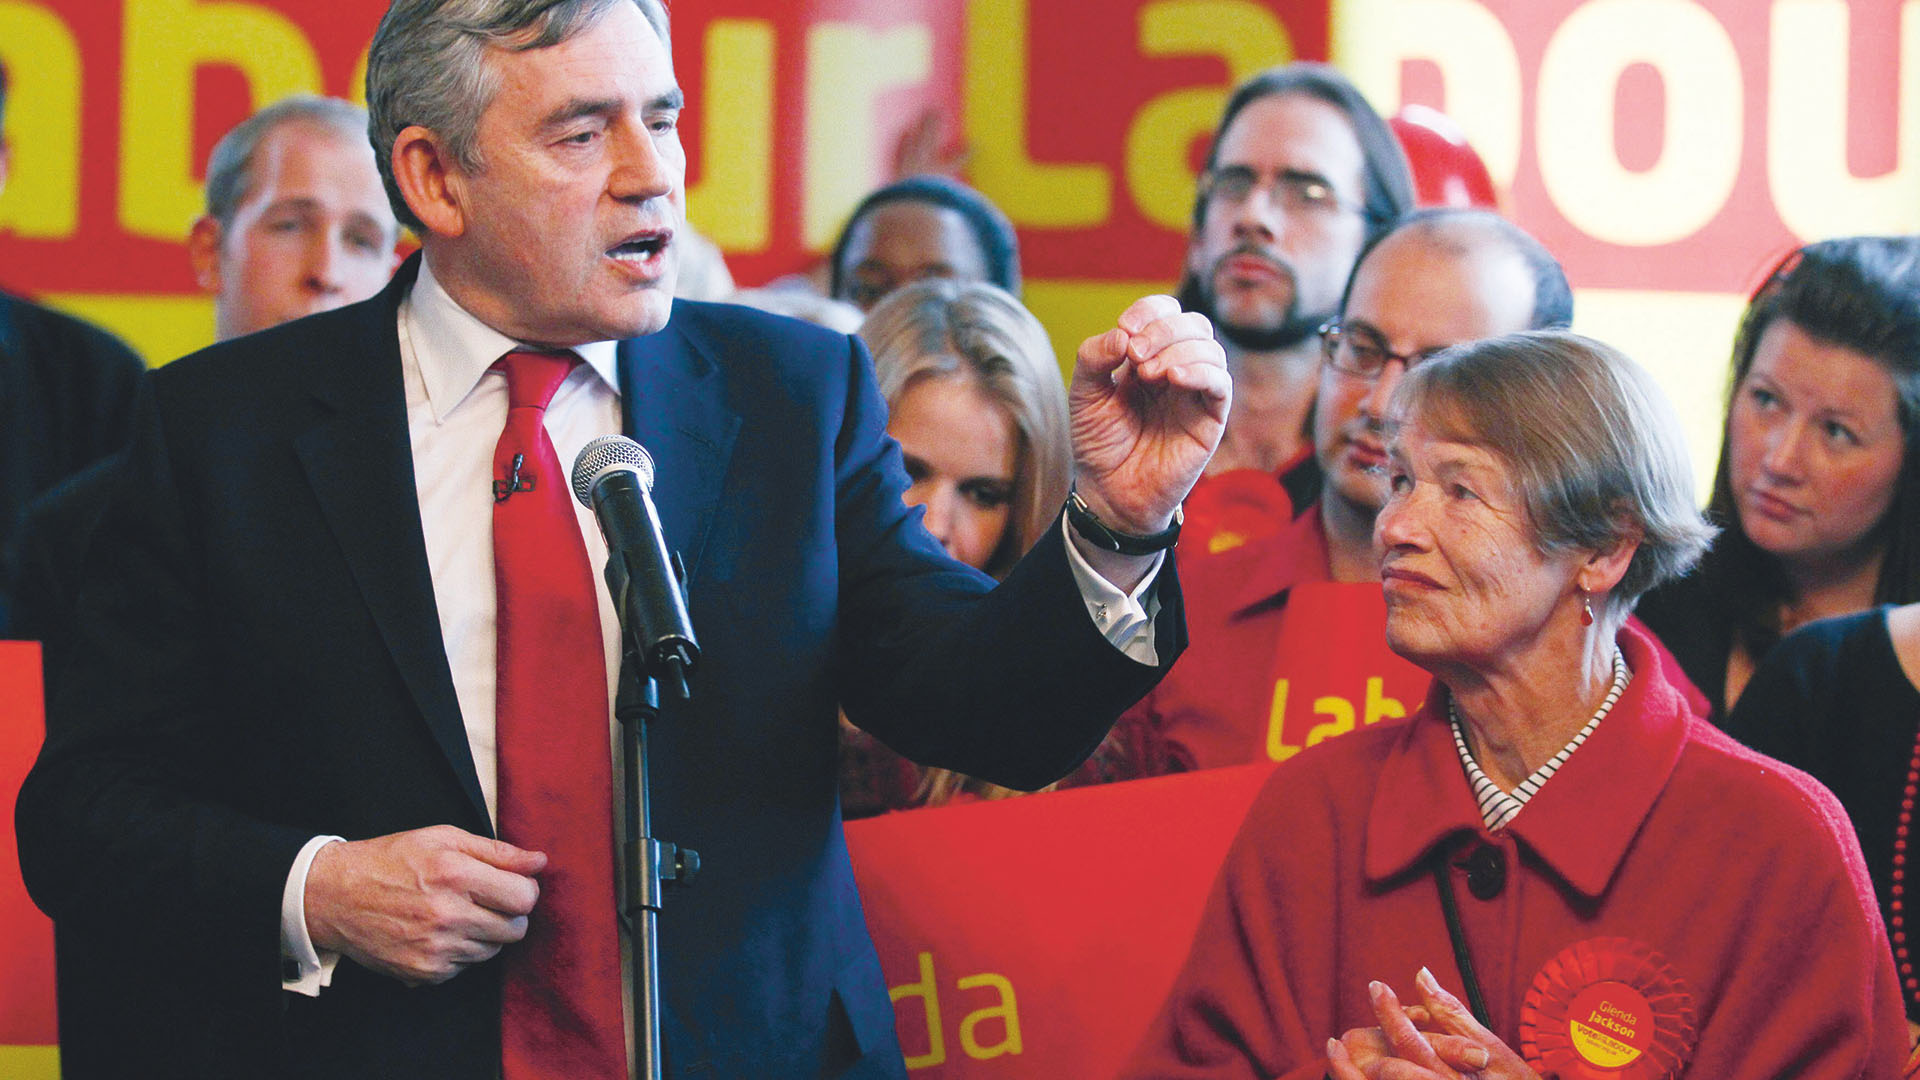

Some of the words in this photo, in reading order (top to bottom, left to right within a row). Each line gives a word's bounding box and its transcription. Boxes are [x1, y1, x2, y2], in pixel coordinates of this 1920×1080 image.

[1266, 676, 1425, 762] Lab
[1588, 1010, 1635, 1039] Jackson
[1600, 1000, 1637, 1025] Glenda
